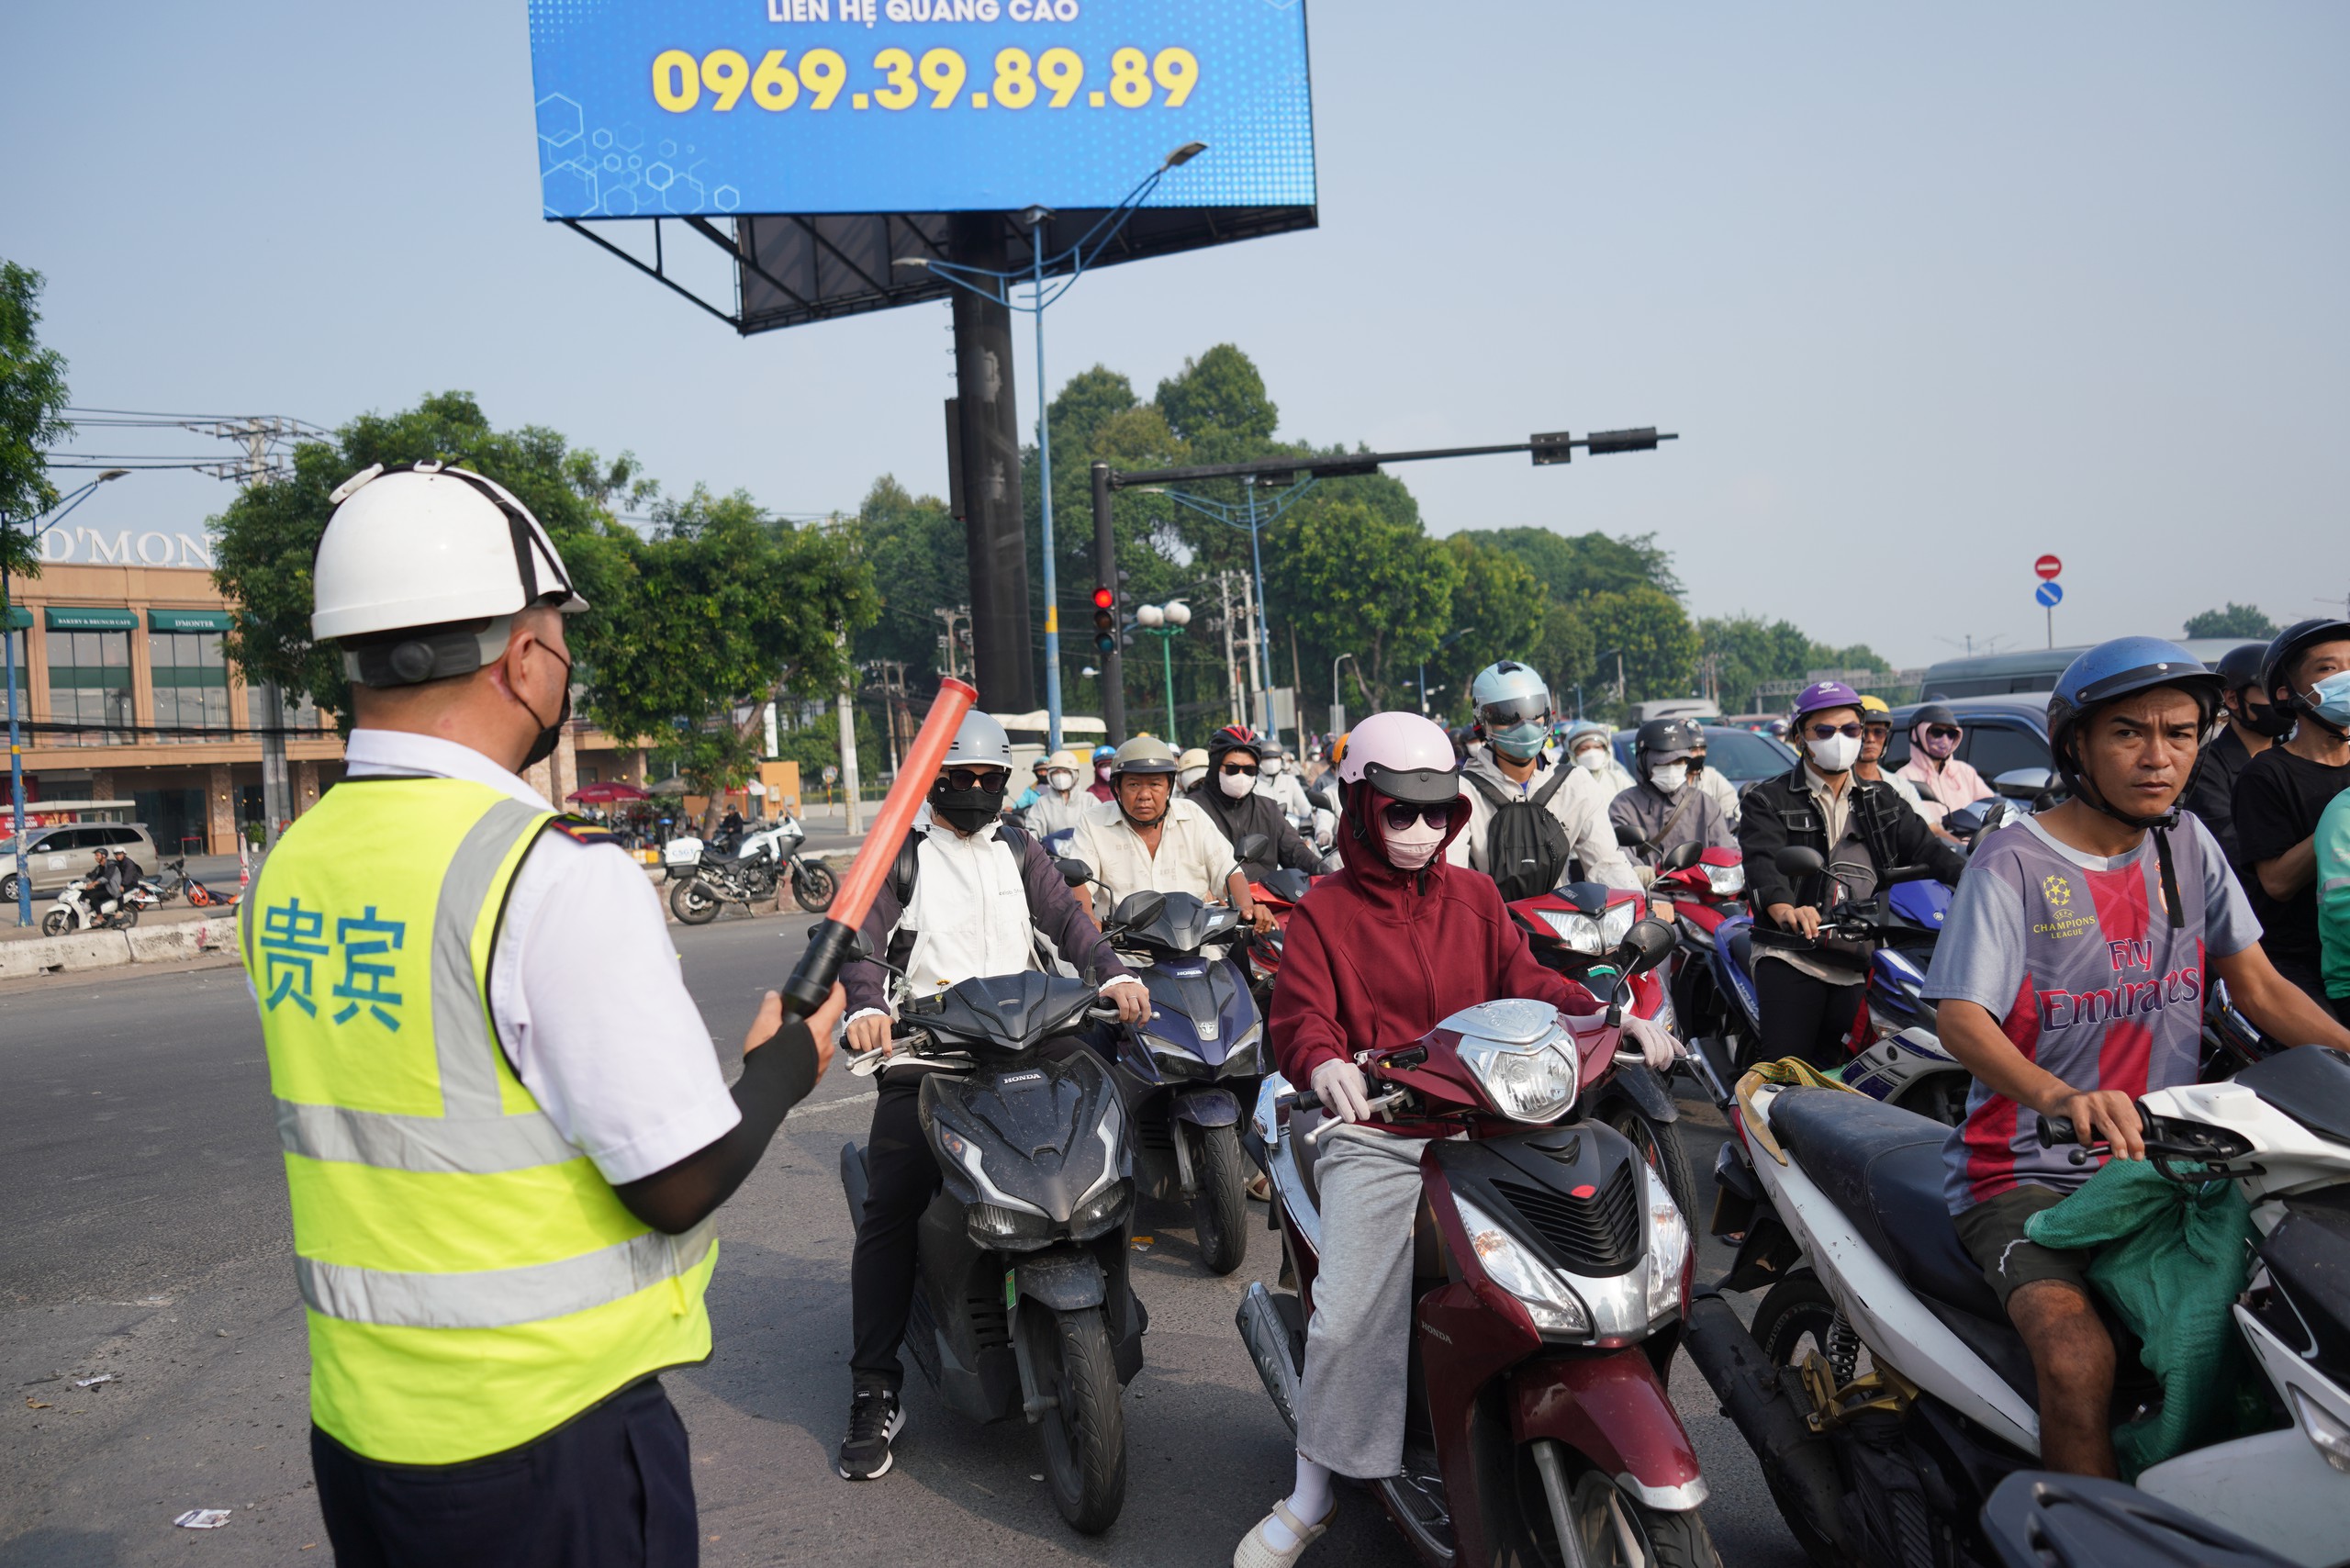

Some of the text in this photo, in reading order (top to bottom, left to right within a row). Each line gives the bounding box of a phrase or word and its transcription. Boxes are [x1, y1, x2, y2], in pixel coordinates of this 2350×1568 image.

[652, 47, 1199, 113] 0969.39.89.89
[35, 526, 226, 569] D'MON
[174, 619, 215, 628] D'MONTER
[2032, 915, 2096, 934] CHAMPIONS
[2054, 910, 2073, 920] UEFA
[2051, 928, 2084, 939] LEAGUE
[260, 897, 406, 1033] 贵宾
[2107, 938, 2153, 972] Fly
[1002, 1073, 1042, 1084] HONDA
[1421, 1319, 1453, 1345] HONDA
